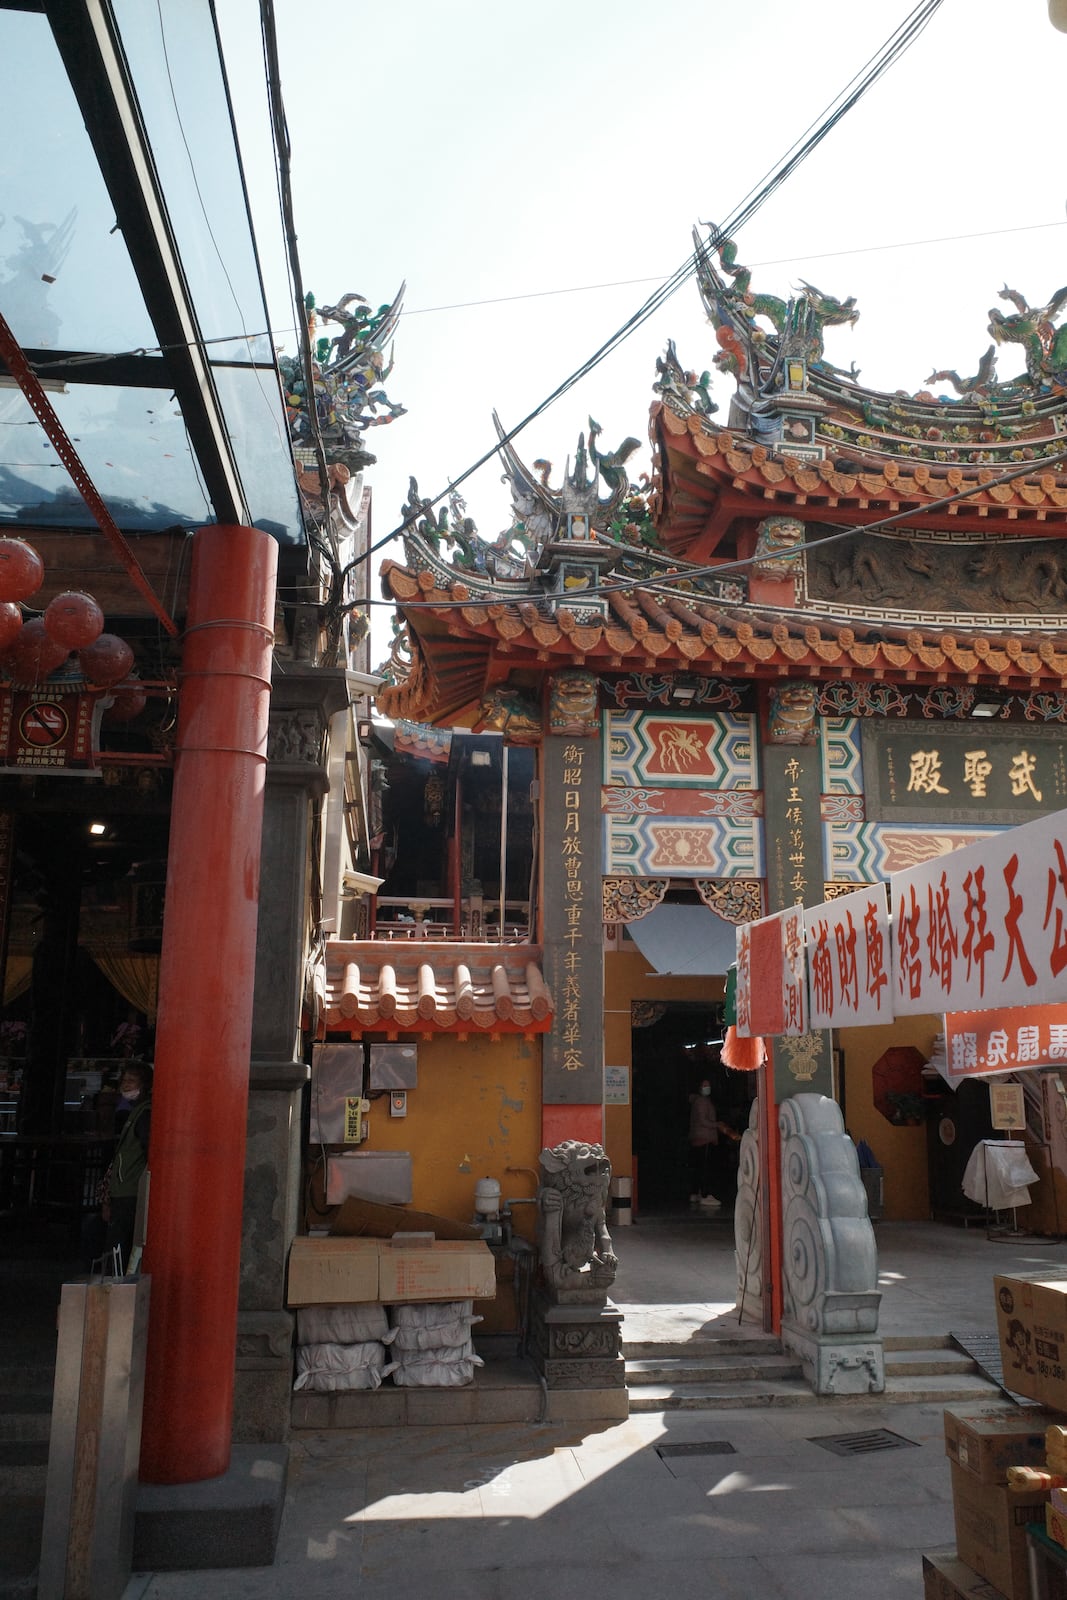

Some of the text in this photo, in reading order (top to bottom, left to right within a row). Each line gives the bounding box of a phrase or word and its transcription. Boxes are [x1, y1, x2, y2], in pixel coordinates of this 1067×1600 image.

[906, 750, 1042, 802] 武聖殿
[811, 900, 888, 1019] 補財庫
